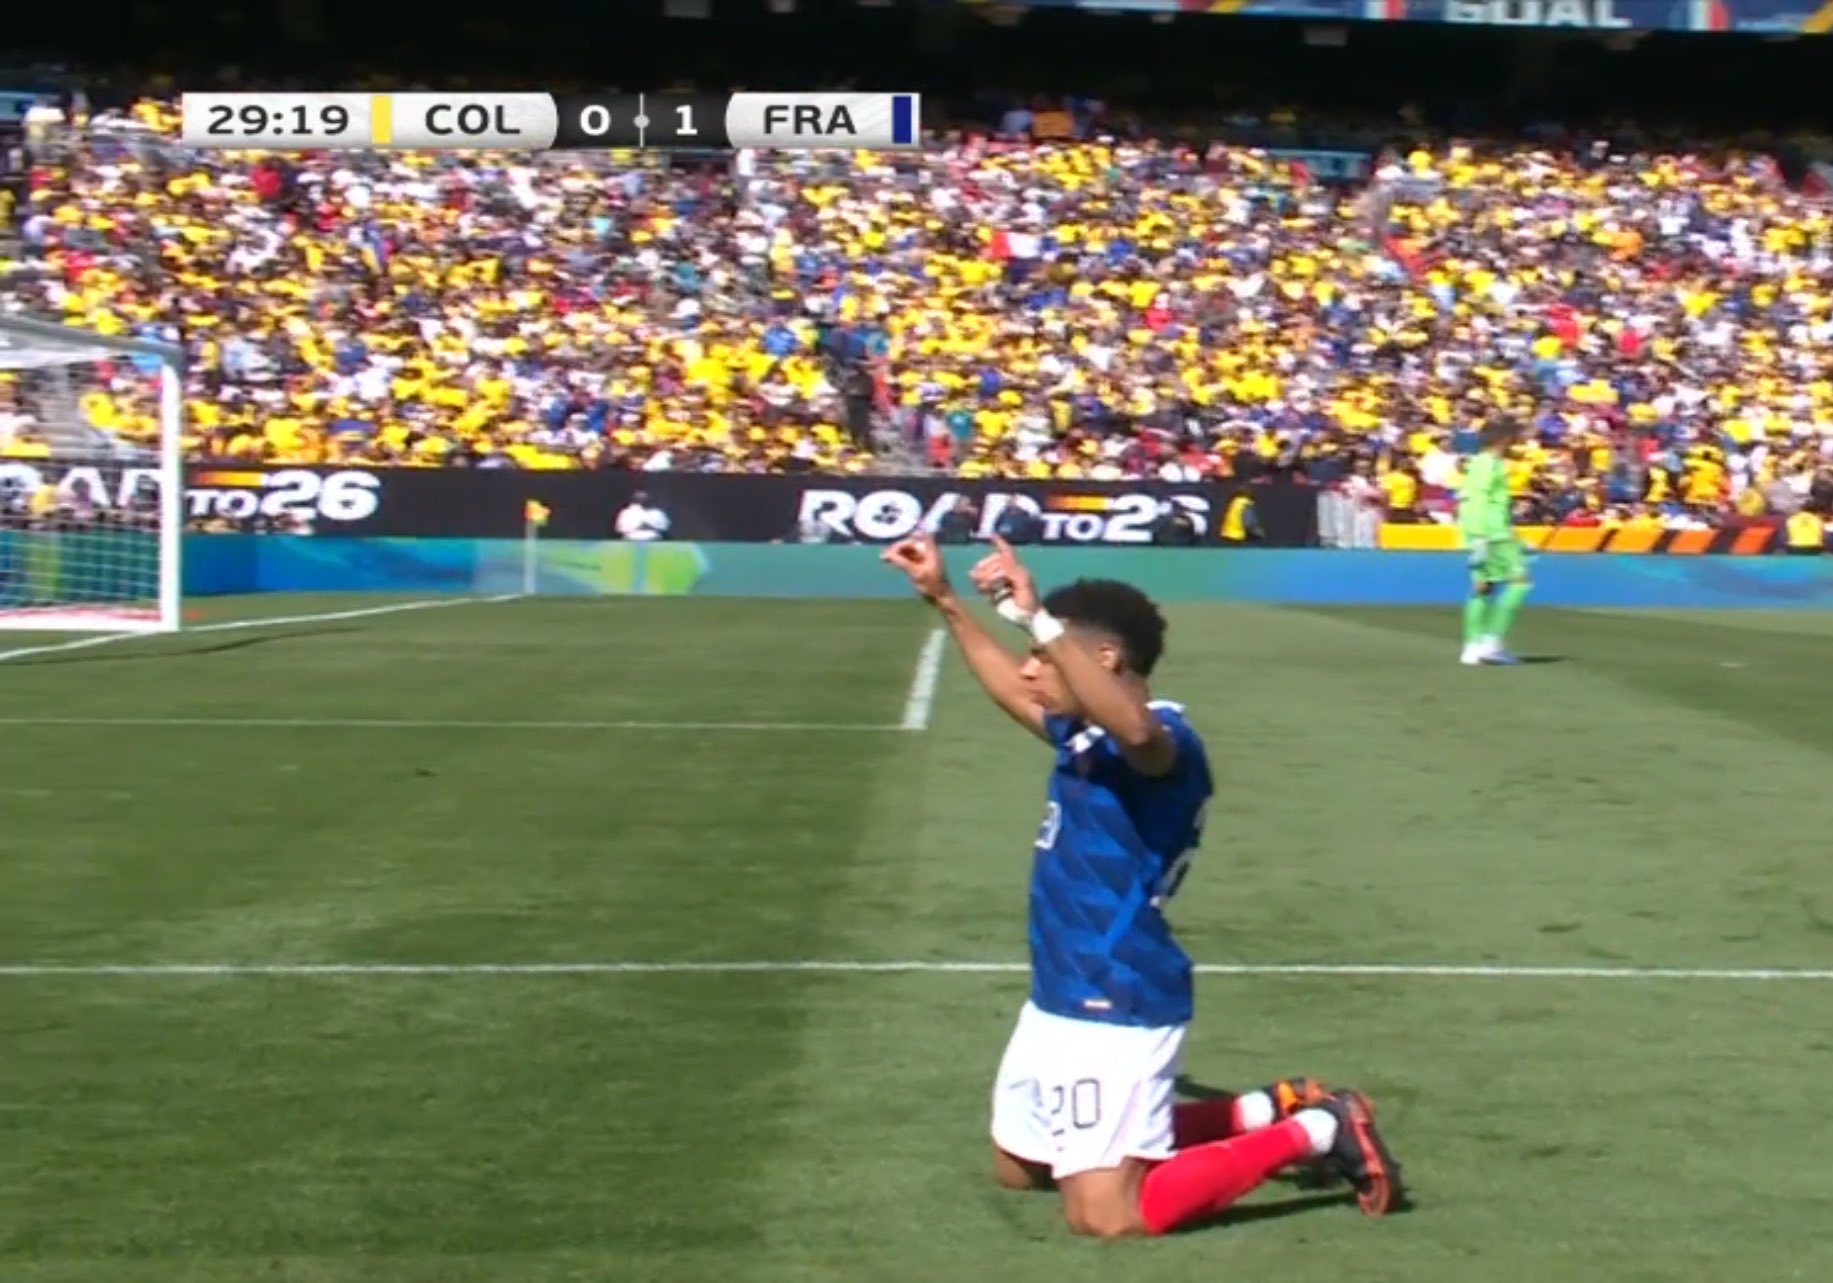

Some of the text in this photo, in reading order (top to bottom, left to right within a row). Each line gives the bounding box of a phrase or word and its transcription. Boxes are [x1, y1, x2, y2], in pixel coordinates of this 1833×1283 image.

[184, 489, 258, 519] TO
[262, 470, 381, 521] 26
[1041, 512, 1104, 541] TO
